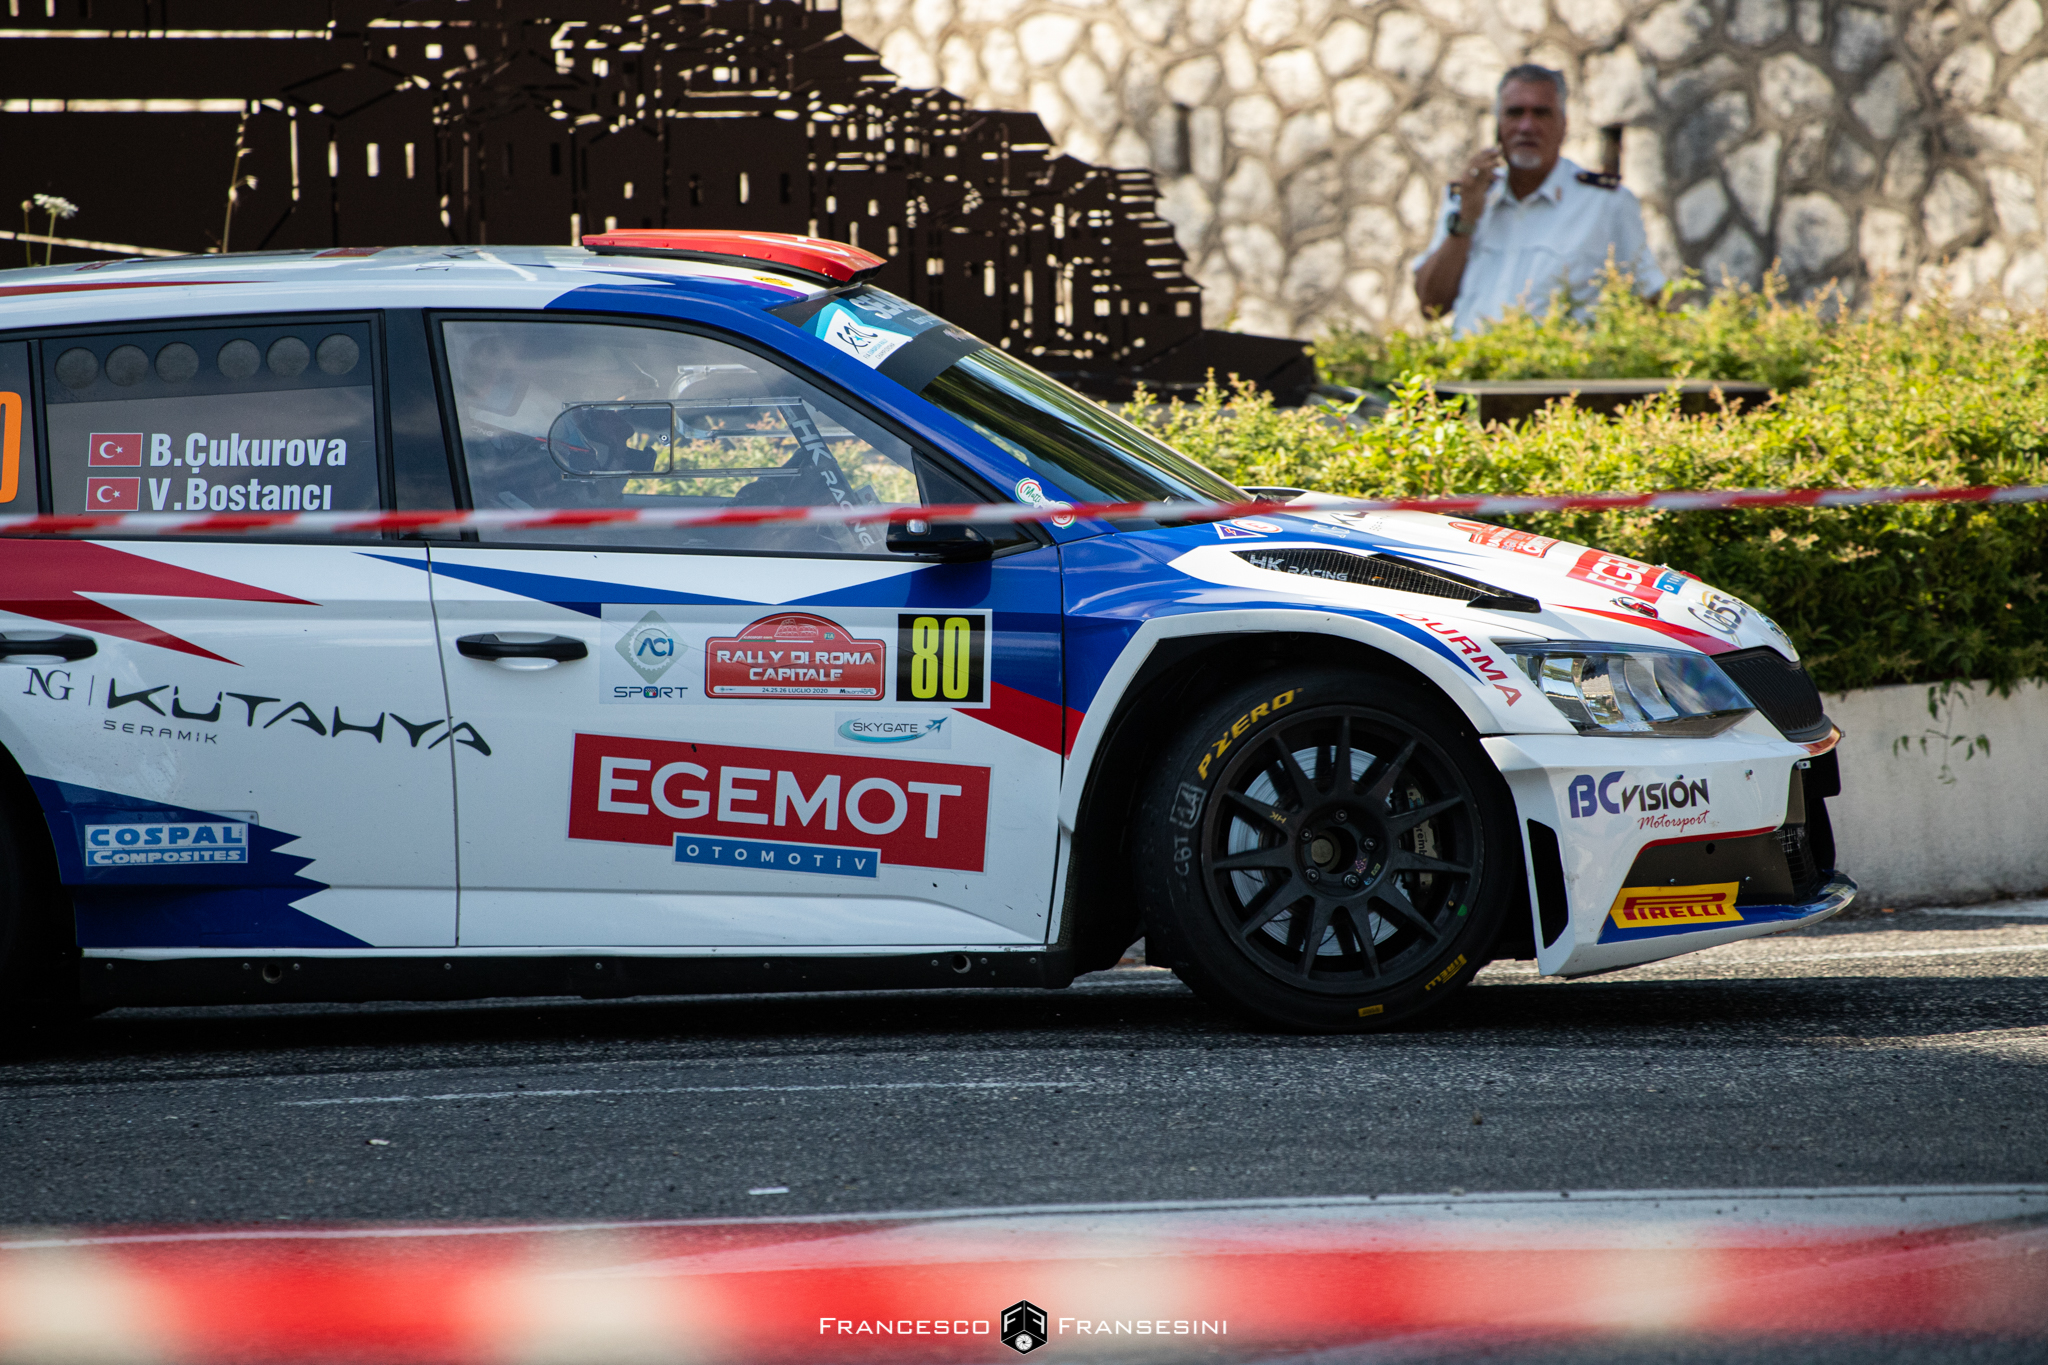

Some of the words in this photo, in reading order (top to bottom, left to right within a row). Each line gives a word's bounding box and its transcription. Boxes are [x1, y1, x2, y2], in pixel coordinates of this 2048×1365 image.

[150, 433, 347, 473] B.Çukurova
[792, 419, 832, 467] HK
[1250, 554, 1285, 572] HK
[1287, 565, 1349, 582] RACING
[637, 637, 674, 657] ACI
[716, 650, 784, 663] RALLY
[790, 651, 809, 664] DI
[816, 651, 875, 665] ROMA
[911, 617, 971, 699] 80
[22, 667, 75, 700] NG
[750, 668, 843, 681] CAPITALE
[614, 686, 688, 699] SPORT
[853, 721, 918, 733] SKYGATE
[598, 756, 962, 839] EGEMOT
[1637, 809, 1710, 833] Motorsport
[90, 826, 243, 847] COSPAL
[93, 850, 241, 864] COMPOSITES
[1623, 892, 1727, 921] PIRELLI
[1425, 953, 1467, 991] PIRELLI
